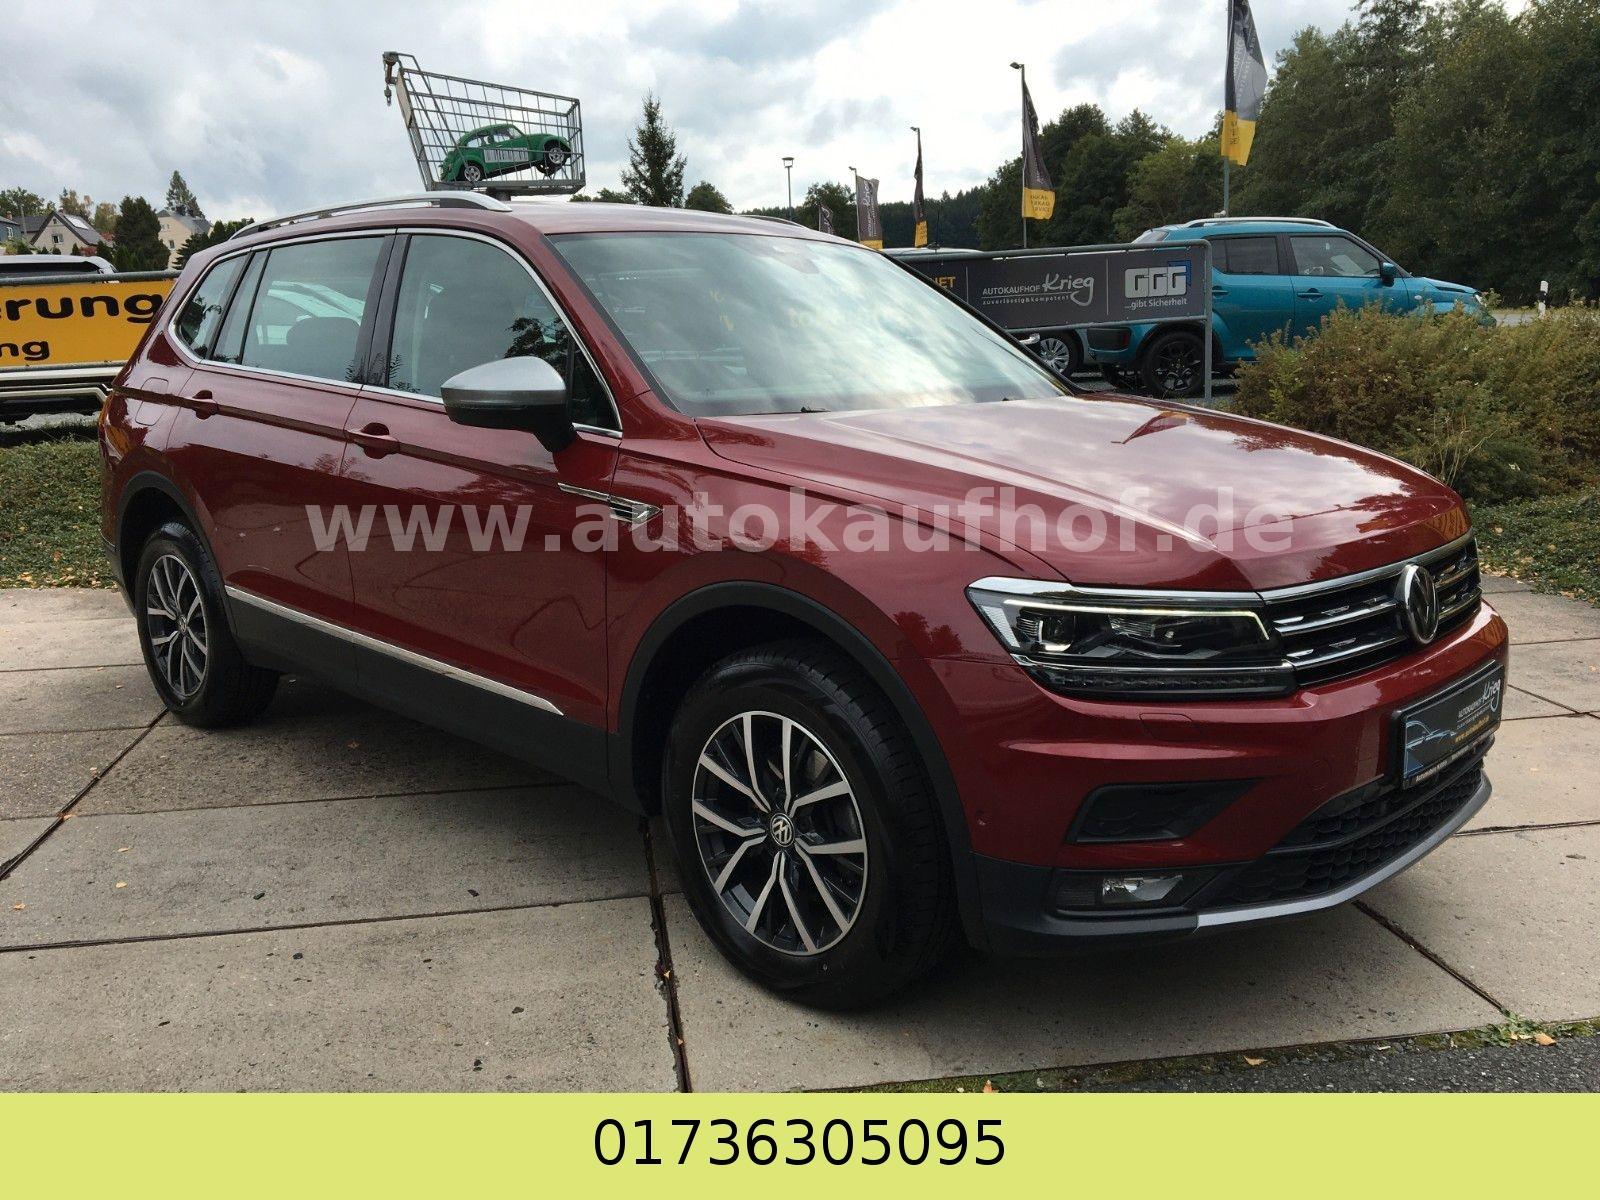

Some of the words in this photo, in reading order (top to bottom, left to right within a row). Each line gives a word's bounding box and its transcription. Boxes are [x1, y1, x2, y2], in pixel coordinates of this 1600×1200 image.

[982, 284, 1041, 296] AUTOKAUFHOF
[1041, 272, 1095, 307] Krieg
[1148, 298, 1187, 308] Sicherheit
[0, 293, 164, 324] rung
